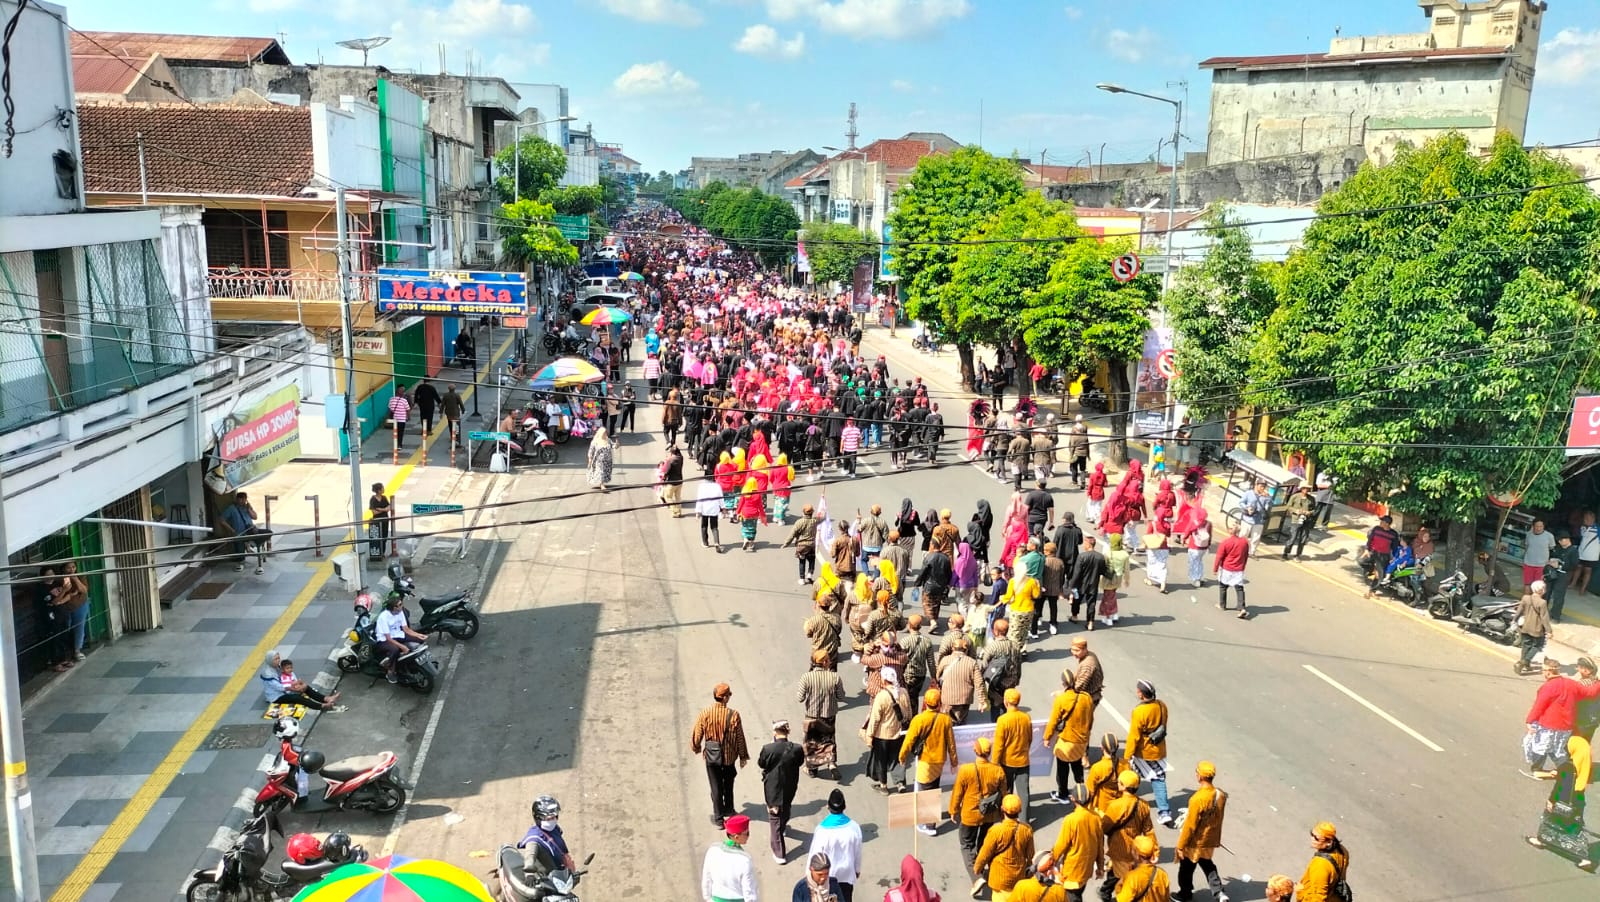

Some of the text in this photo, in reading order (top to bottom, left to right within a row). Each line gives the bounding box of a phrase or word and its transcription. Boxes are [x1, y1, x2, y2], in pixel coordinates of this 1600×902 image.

[392, 282, 512, 303] Merdeka
[356, 341, 383, 350] DEWI
[226, 430, 257, 456] BURSA
[257, 422, 269, 439] HP
